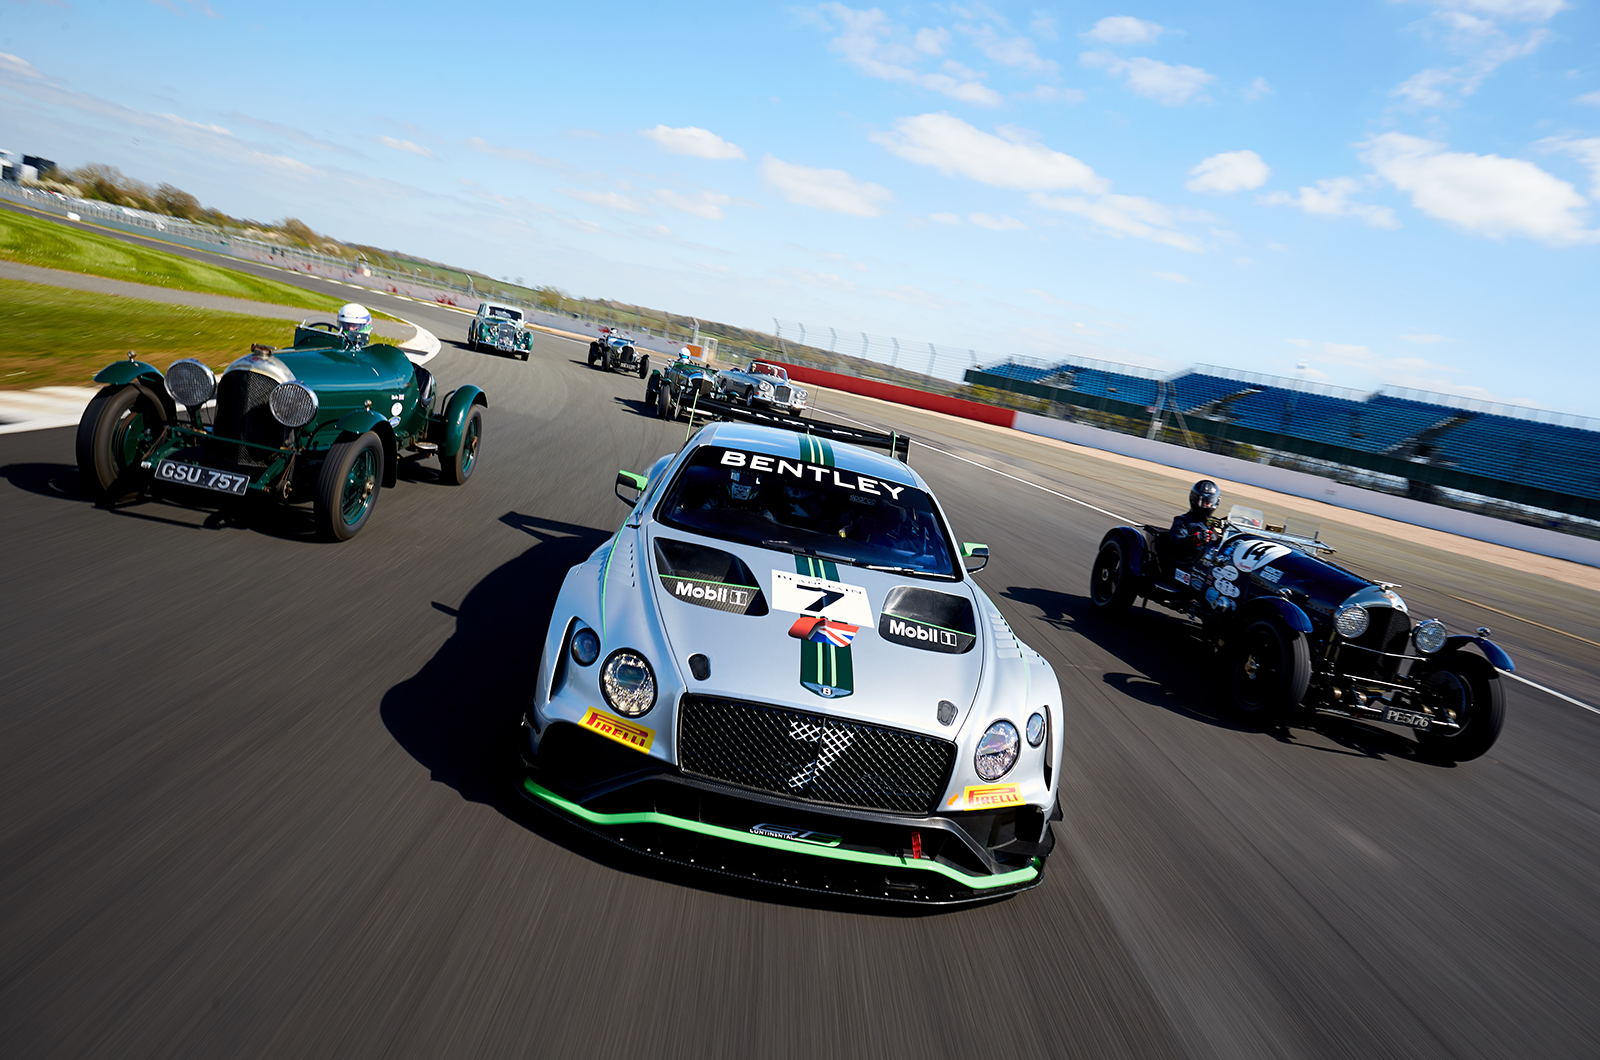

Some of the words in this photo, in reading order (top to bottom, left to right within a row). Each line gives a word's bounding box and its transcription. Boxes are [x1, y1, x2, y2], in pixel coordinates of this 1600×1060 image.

[162, 462, 202, 483] GSU
[207, 470, 245, 492] 757
[720, 450, 905, 500] BENTLEY
[1241, 541, 1278, 561] 14
[675, 581, 728, 603] Mobil
[796, 583, 845, 612] 7
[889, 619, 938, 643] Mobil
[822, 687, 832, 696] B
[586, 711, 649, 747] PIRELLI
[968, 787, 1019, 806] PIRELLI
[749, 828, 796, 841] CONTINENTAL
